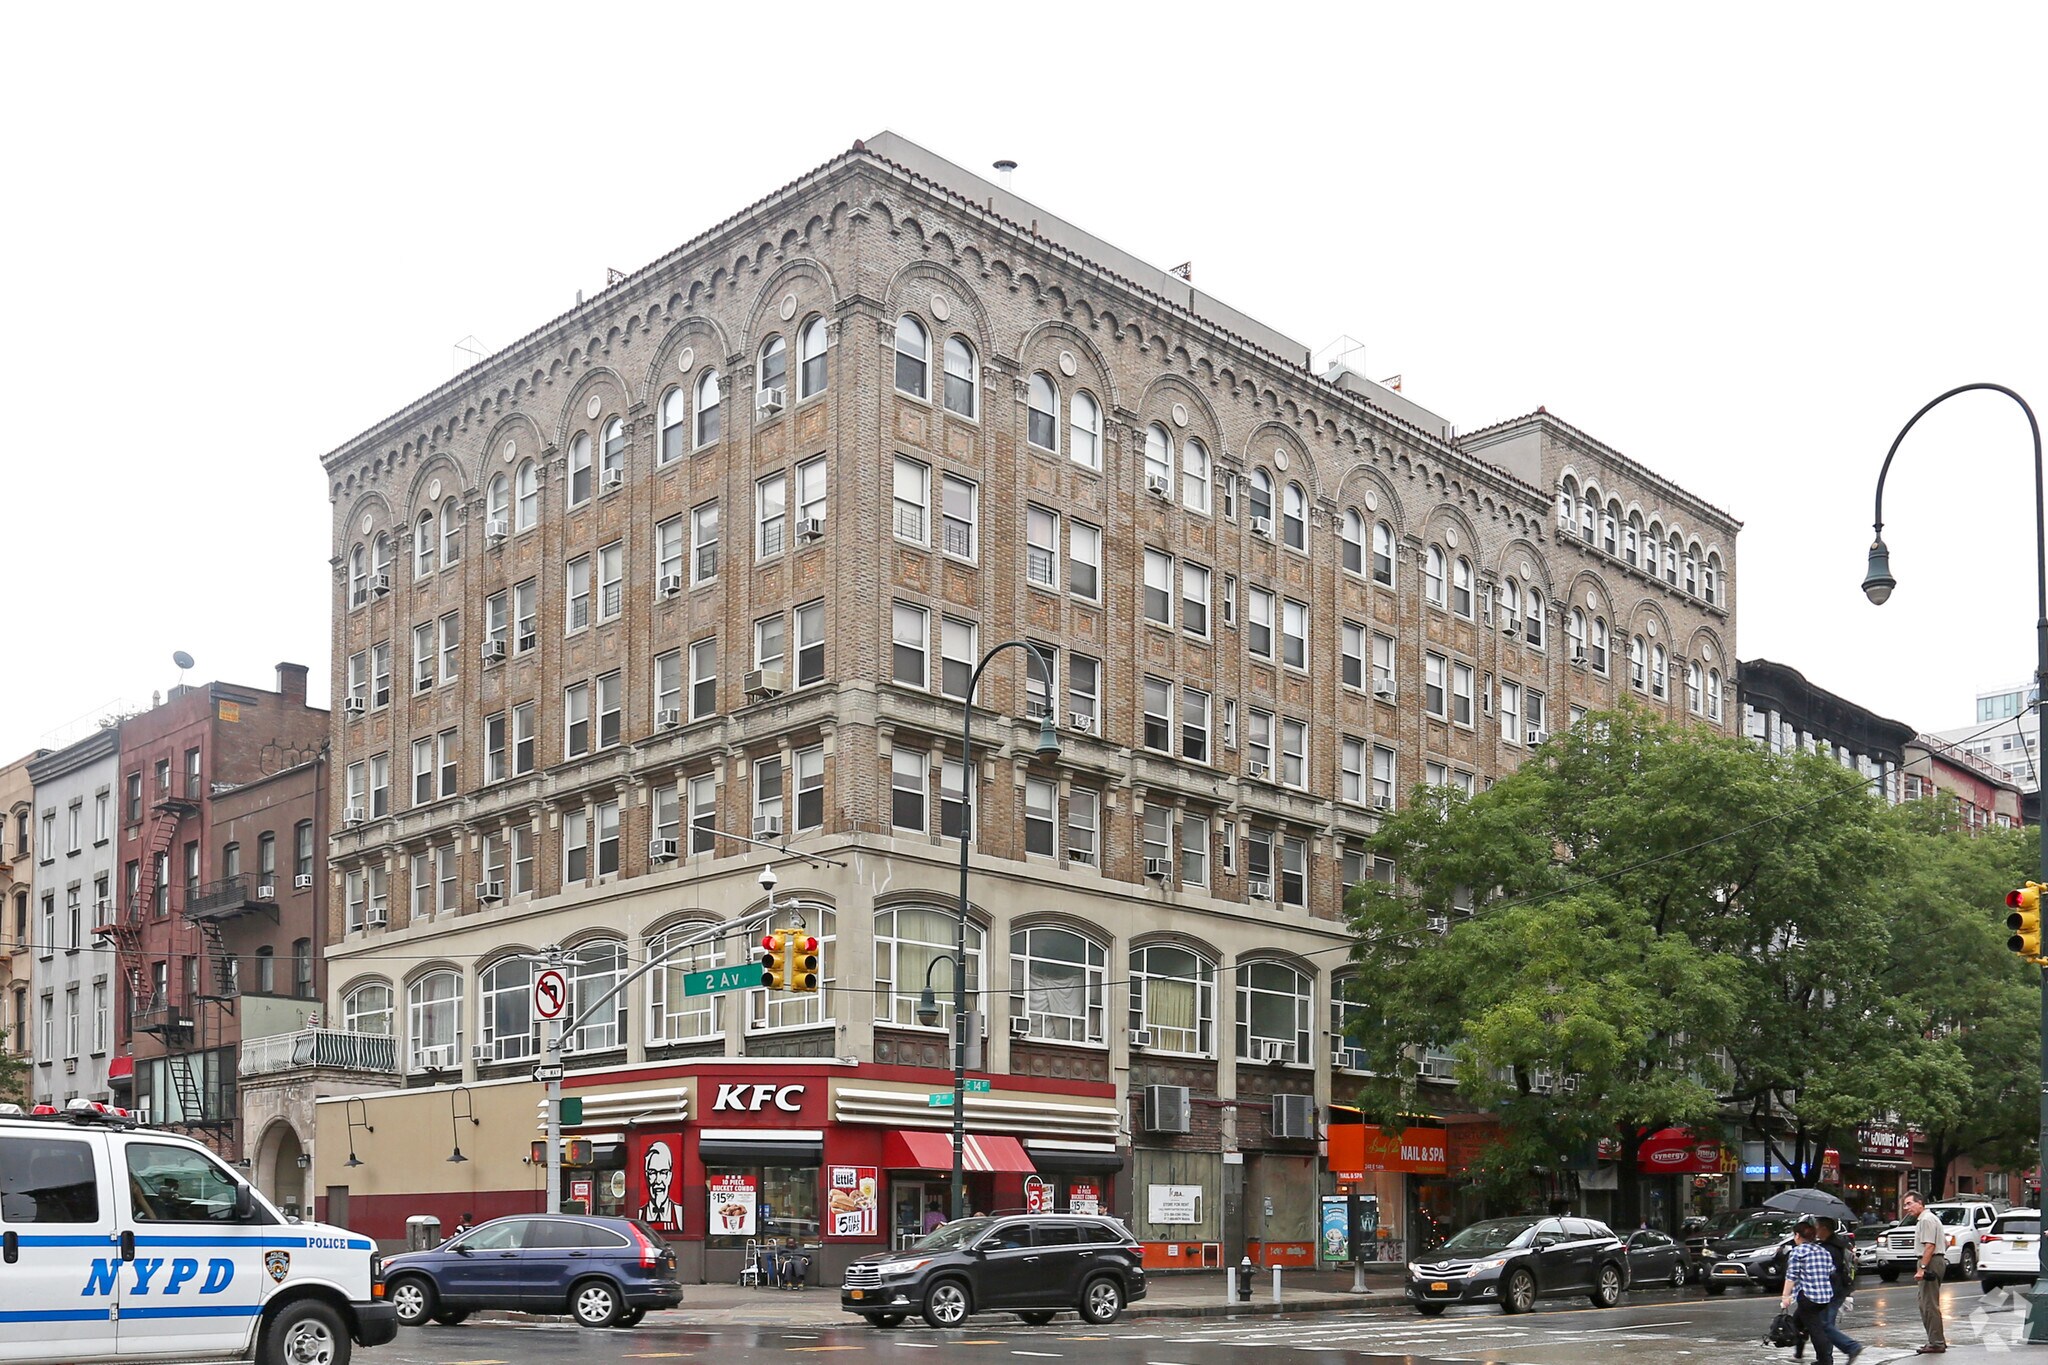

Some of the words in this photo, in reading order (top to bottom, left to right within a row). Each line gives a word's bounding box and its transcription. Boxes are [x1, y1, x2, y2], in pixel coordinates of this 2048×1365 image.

[705, 974, 715, 990] 2
[720, 972, 739, 988] Av
[974, 1081, 981, 1091] 14
[711, 1083, 805, 1112] KFC
[935, 1094, 941, 1105] 2
[1871, 1132, 1896, 1147] GOURMET
[1401, 1145, 1420, 1161] NAIL
[1421, 1146, 1428, 1161] &
[1429, 1147, 1445, 1162] SPA
[1654, 1151, 1685, 1160] synergy
[848, 1215, 861, 1224] FILL
[848, 1223, 860, 1232] UPS
[309, 1237, 346, 1250] POLICE
[81, 1258, 235, 1296] NYPD
